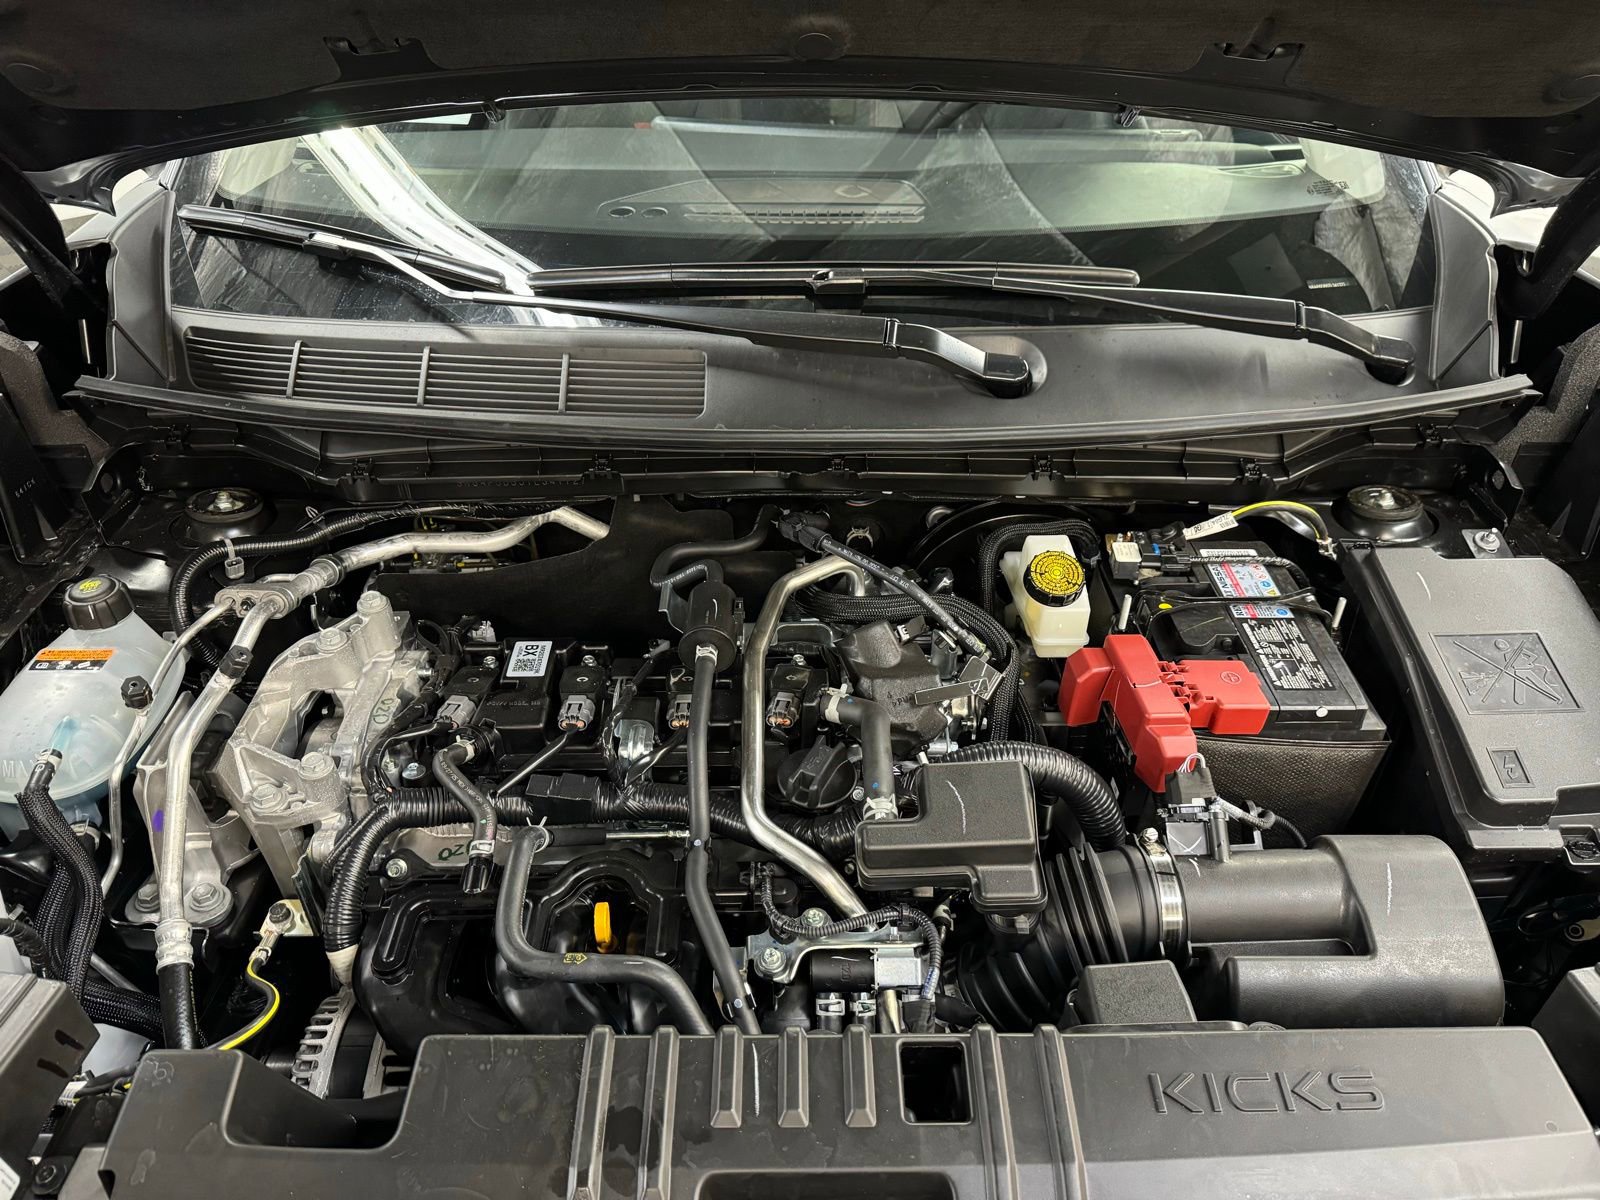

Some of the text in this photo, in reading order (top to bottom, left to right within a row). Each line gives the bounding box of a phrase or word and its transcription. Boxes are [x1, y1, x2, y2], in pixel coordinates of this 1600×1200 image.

[1211, 563, 1229, 589] NISSA
[525, 644, 539, 657] BX
[1148, 1070, 1385, 1114] KICKS
